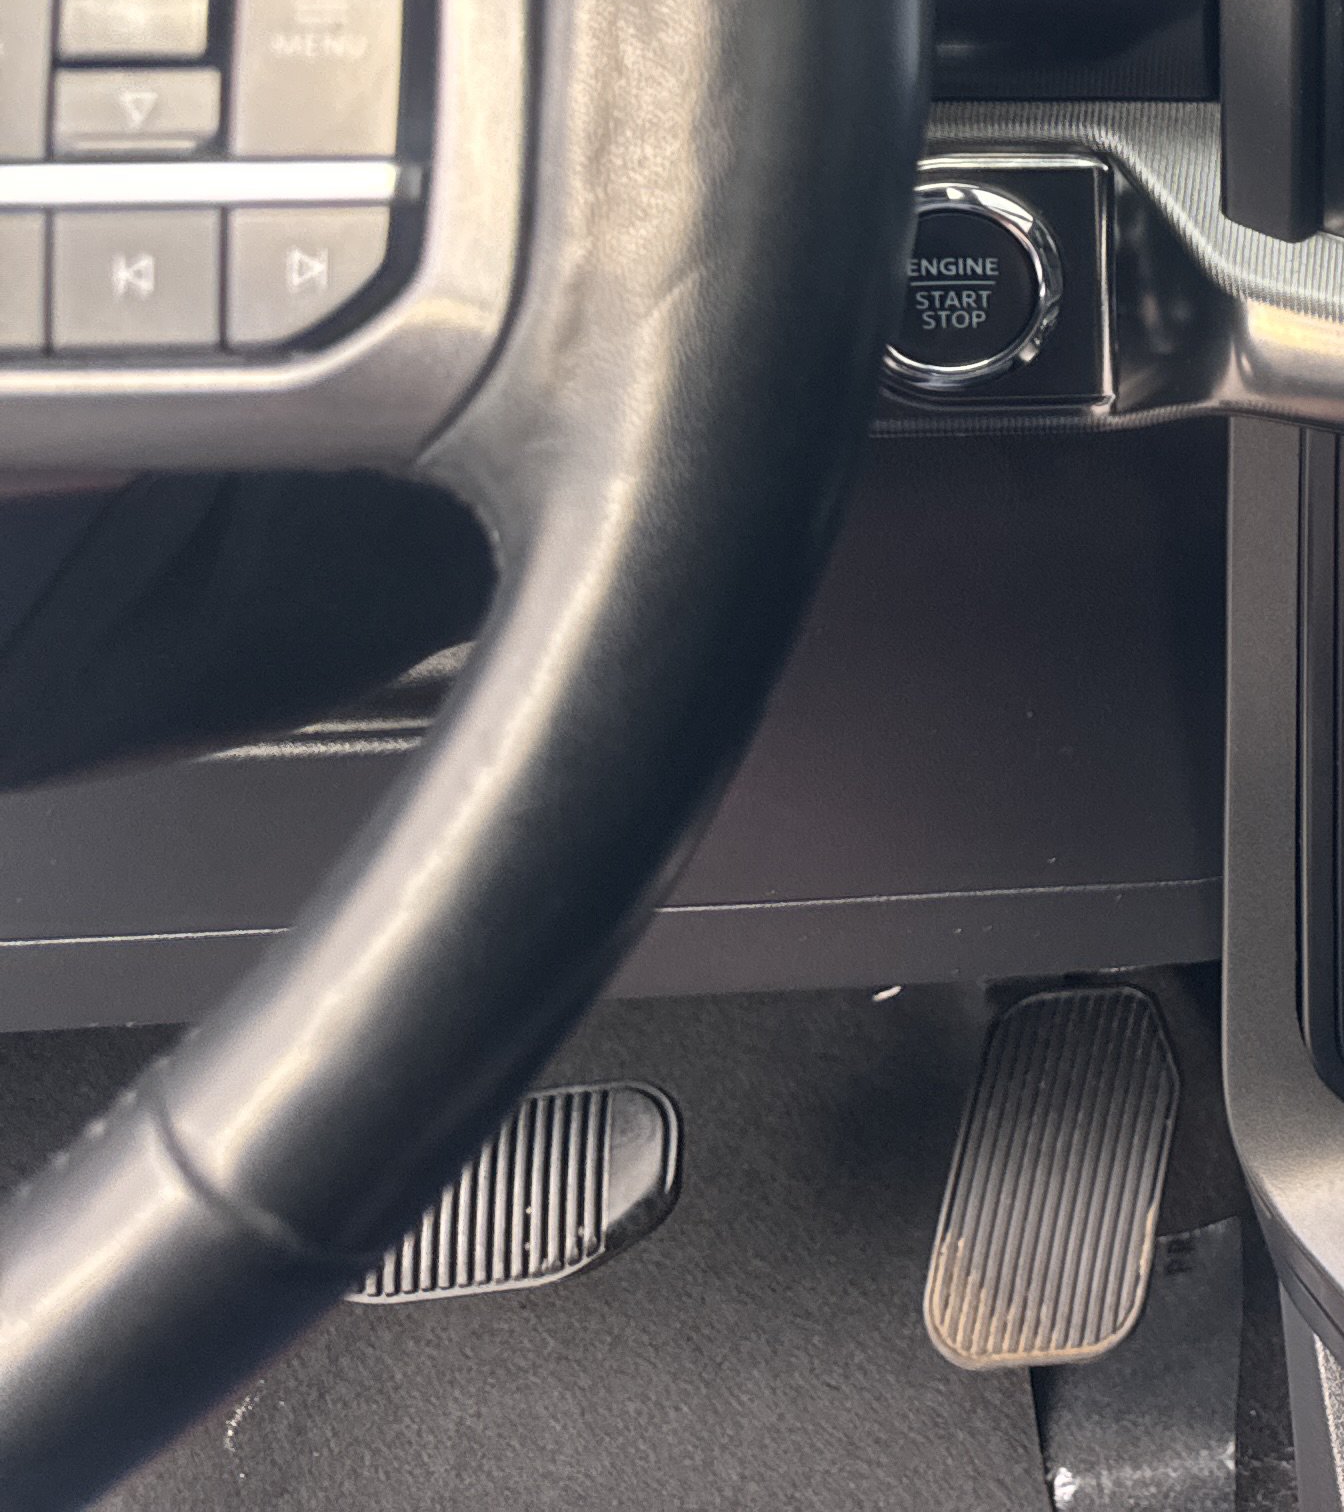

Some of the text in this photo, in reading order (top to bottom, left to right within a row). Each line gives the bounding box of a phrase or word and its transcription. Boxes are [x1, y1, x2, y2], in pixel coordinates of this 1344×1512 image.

[907, 257, 999, 276] ENGINE
[915, 290, 992, 310] START
[922, 310, 987, 330] STOP
